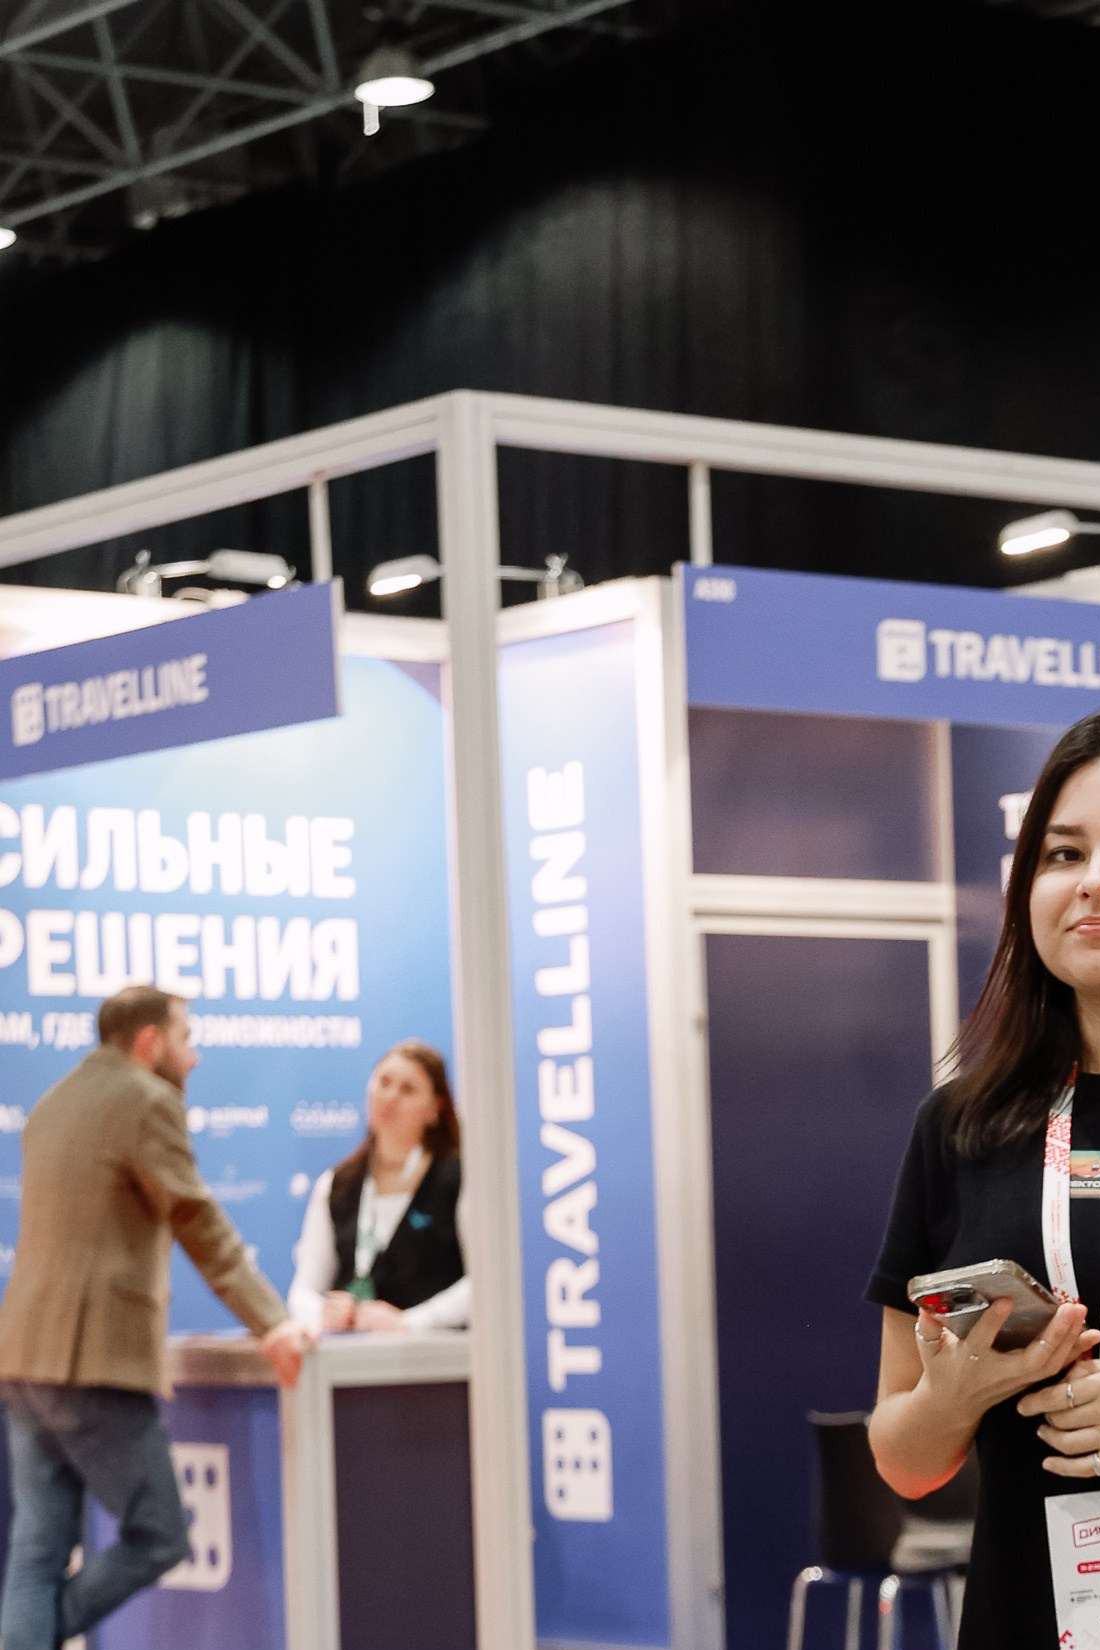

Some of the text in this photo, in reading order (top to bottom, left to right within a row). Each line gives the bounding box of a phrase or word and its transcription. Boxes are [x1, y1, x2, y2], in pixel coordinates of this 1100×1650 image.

[45, 653, 209, 733] TRAVELLINE
[189, 1014, 362, 1048] ОЗМОЖНОСТИ
[527, 760, 601, 1393] TRAVELLINE
